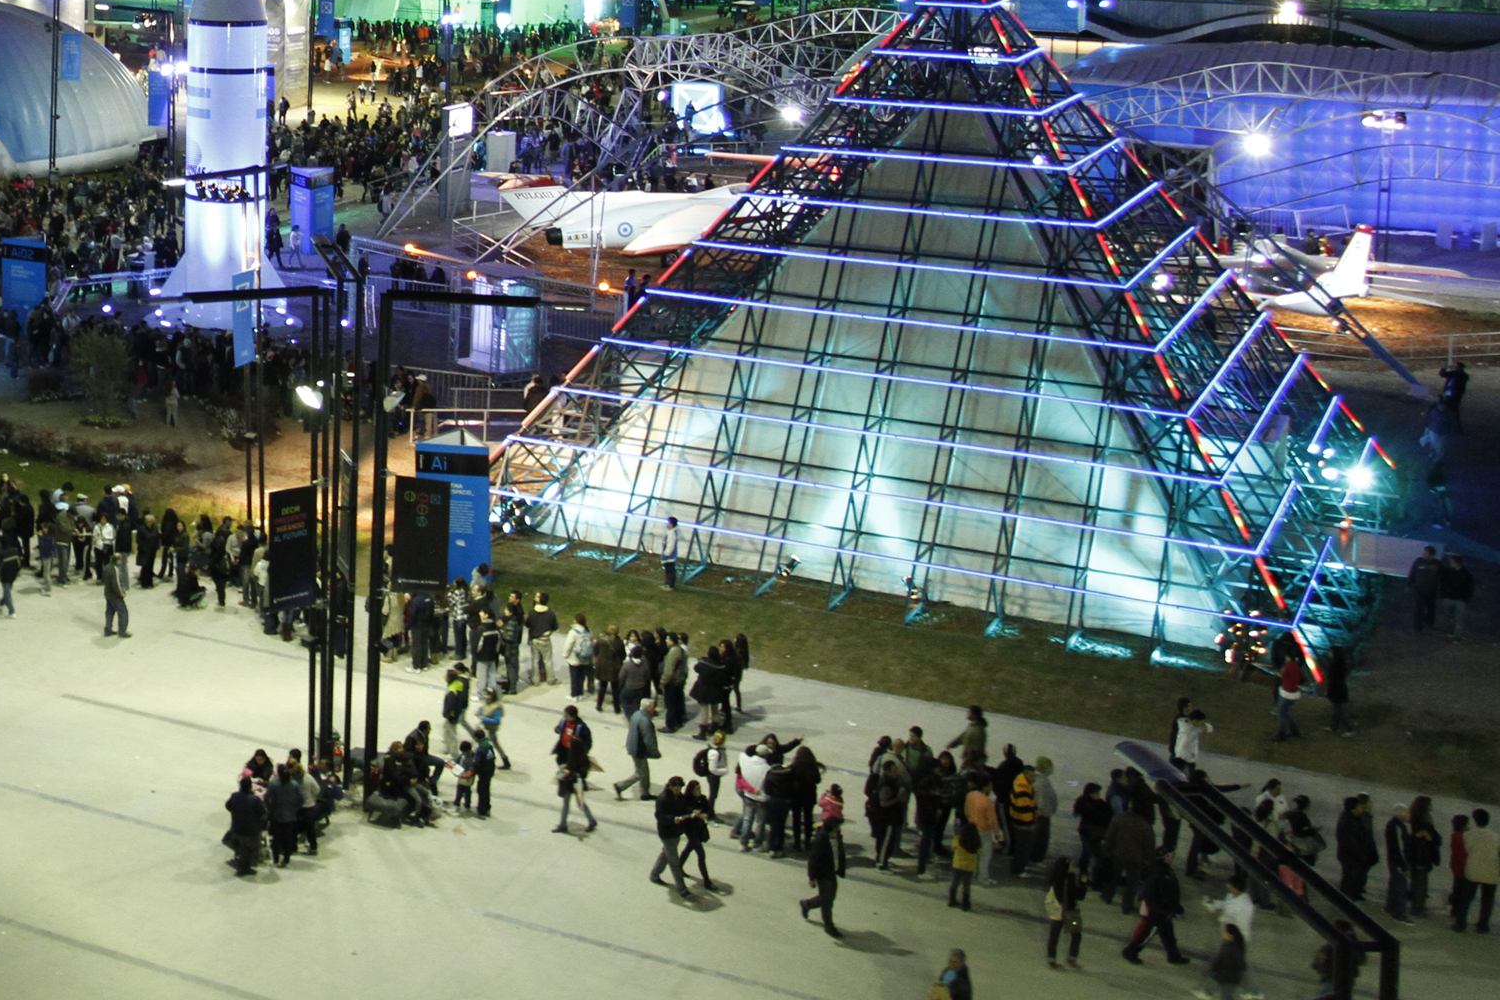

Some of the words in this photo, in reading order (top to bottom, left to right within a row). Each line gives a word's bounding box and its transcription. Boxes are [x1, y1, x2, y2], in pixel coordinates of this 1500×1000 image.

[514, 190, 555, 200] PULQUI
[431, 456, 447, 471] Ai
[283, 529, 308, 540] FUTURO
